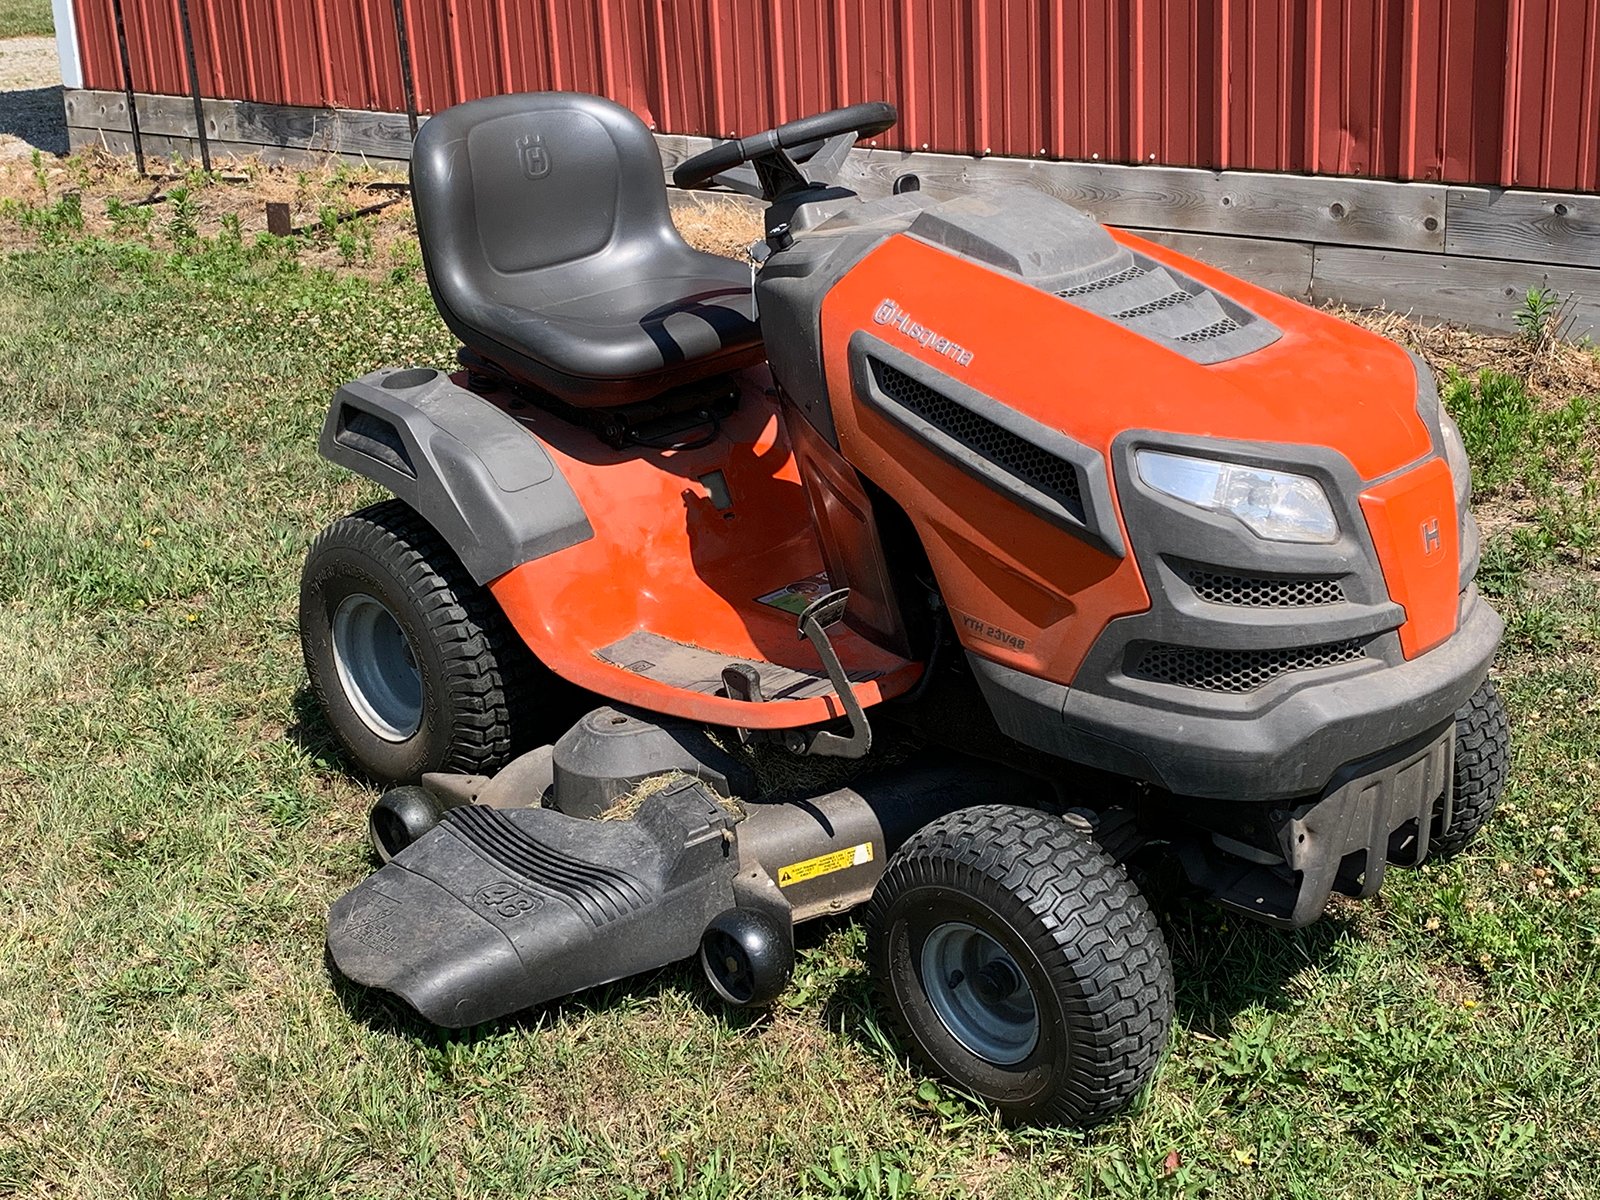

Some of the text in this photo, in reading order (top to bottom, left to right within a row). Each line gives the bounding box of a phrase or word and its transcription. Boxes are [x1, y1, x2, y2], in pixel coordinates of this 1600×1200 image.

[890, 308, 974, 367] Husqvarna
[1422, 518, 1440, 555] H
[961, 615, 1026, 651] YTH 23V48
